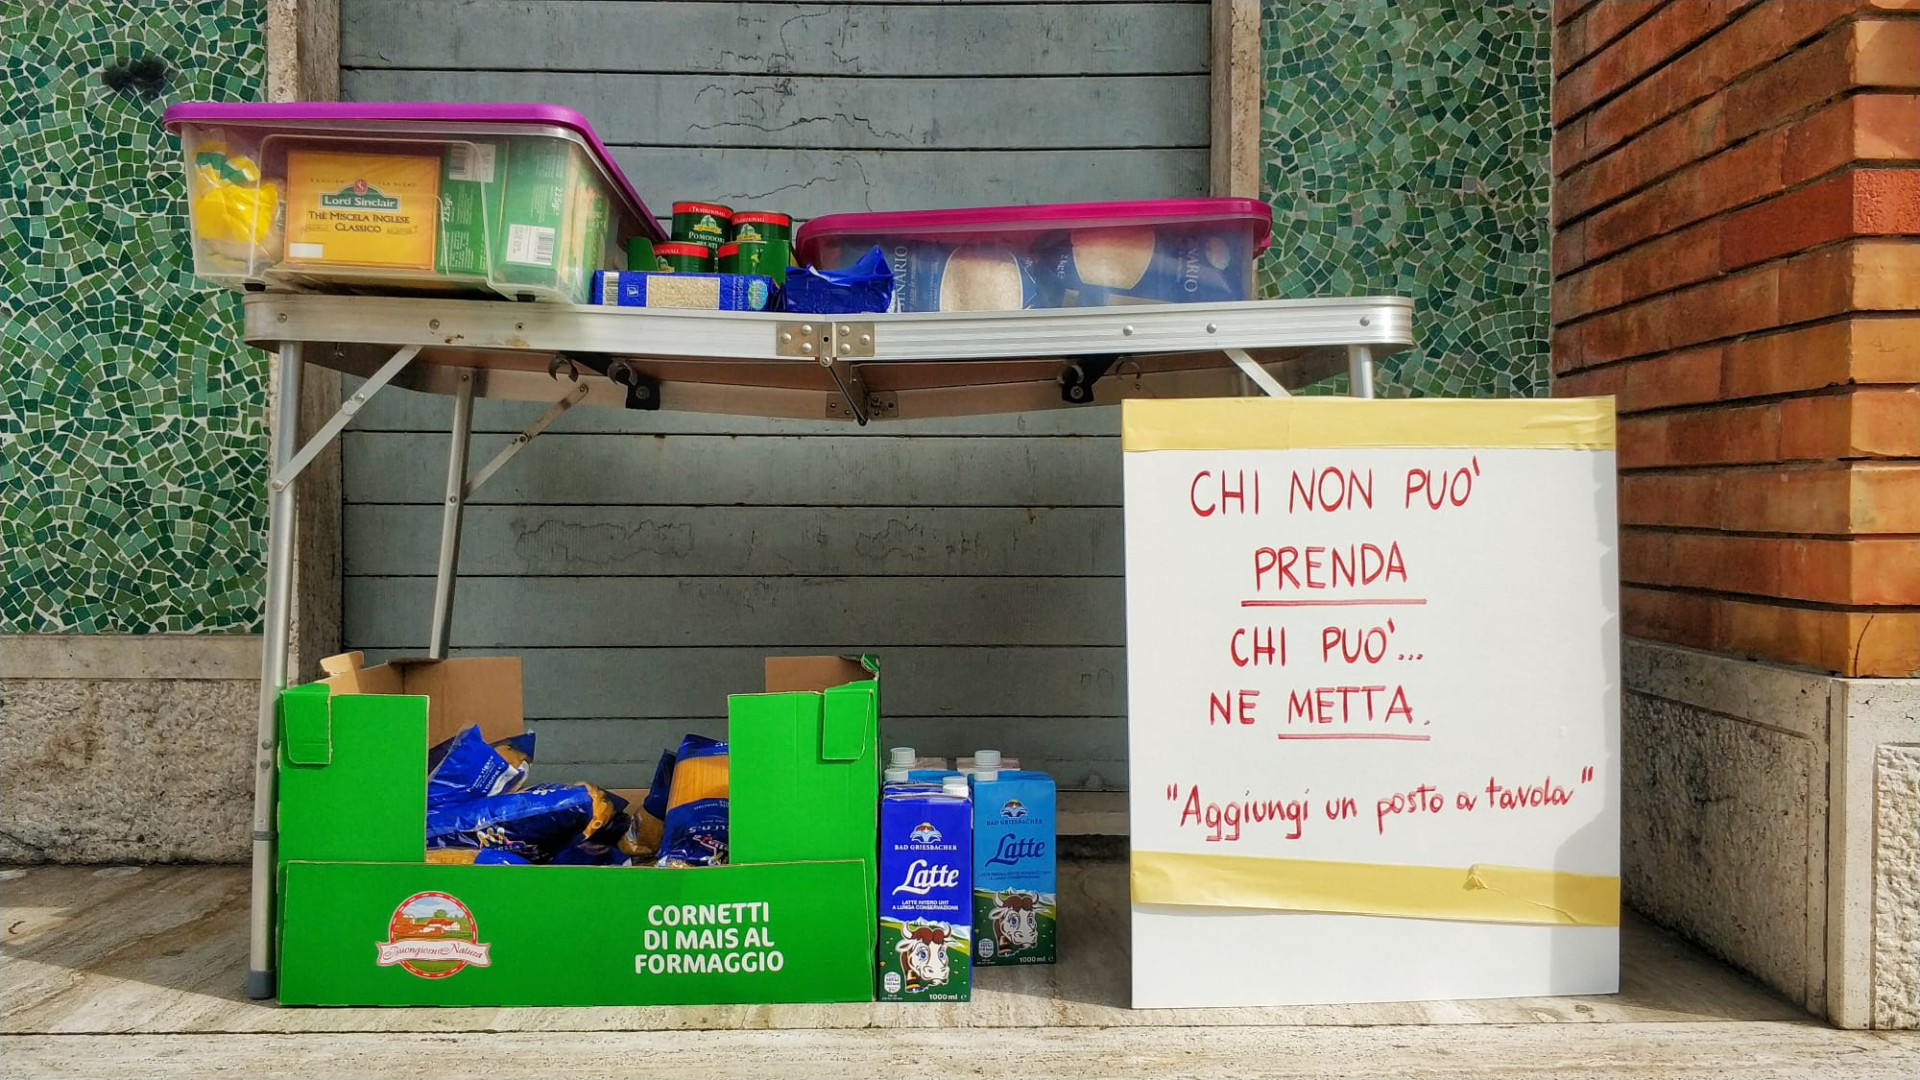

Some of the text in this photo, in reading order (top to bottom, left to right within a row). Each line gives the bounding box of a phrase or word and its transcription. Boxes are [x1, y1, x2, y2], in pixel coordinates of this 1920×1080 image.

[324, 196, 396, 208] Lord Sinclair
[308, 211, 410, 224] THE MISCELA INGLESE
[335, 223, 382, 233] CLASSICO
[688, 231, 725, 244] POMODORI
[1190, 468, 1259, 517] CHI
[1289, 466, 1373, 514] NON
[1254, 540, 1408, 592] PRENDA
[1230, 626, 1286, 667] CHI
[1209, 689, 1260, 725] NE
[1166, 766, 1595, 842] "Aggiungi un posto a tavola"
[985, 833, 1045, 868] Latte
[892, 859, 959, 896] Latte
[648, 902, 769, 926] CORNETTI
[644, 926, 775, 950] DI MAIS AL
[441, 942, 483, 959] Natura
[634, 950, 784, 974] FORMAGGIO
